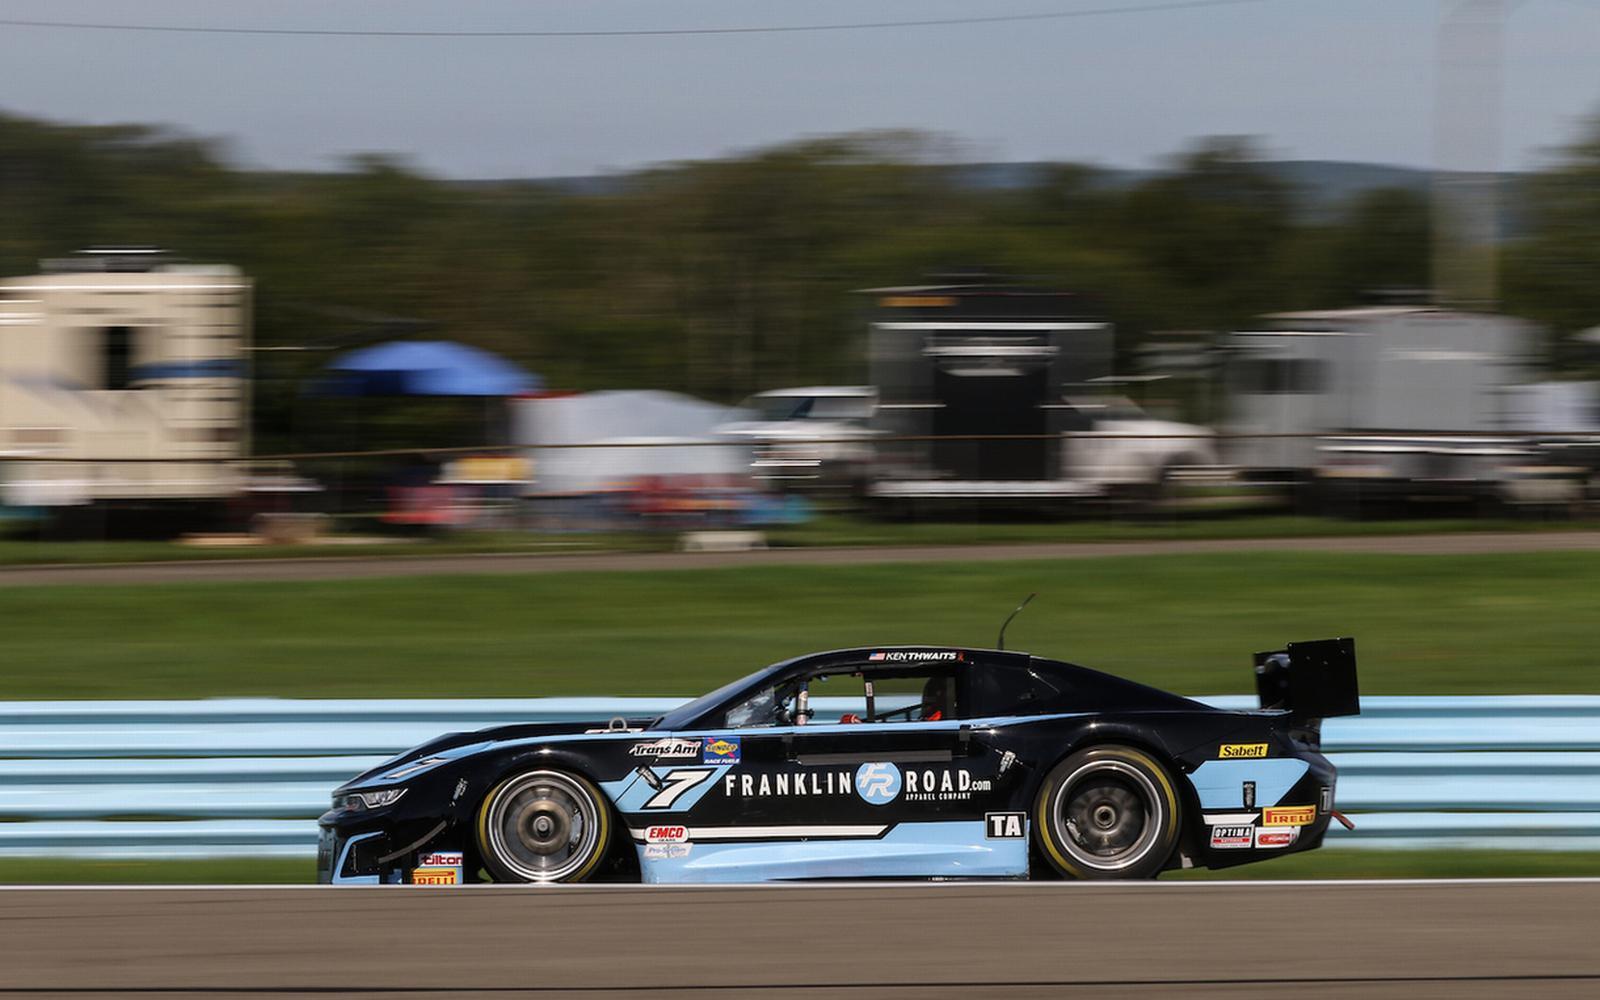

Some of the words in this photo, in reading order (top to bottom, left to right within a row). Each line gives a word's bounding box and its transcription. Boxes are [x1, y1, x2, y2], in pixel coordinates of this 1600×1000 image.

[634, 744, 671, 755] Trans
[705, 743, 738, 752] SUNOCO
[1223, 745, 1264, 757] Sabelt
[643, 769, 715, 808] 7
[725, 771, 851, 797] FRANKLIN
[1265, 808, 1315, 824] PIRELLI
[990, 815, 1022, 836] TA
[649, 827, 684, 838] EMCO
[1214, 828, 1251, 838] OPTIMA
